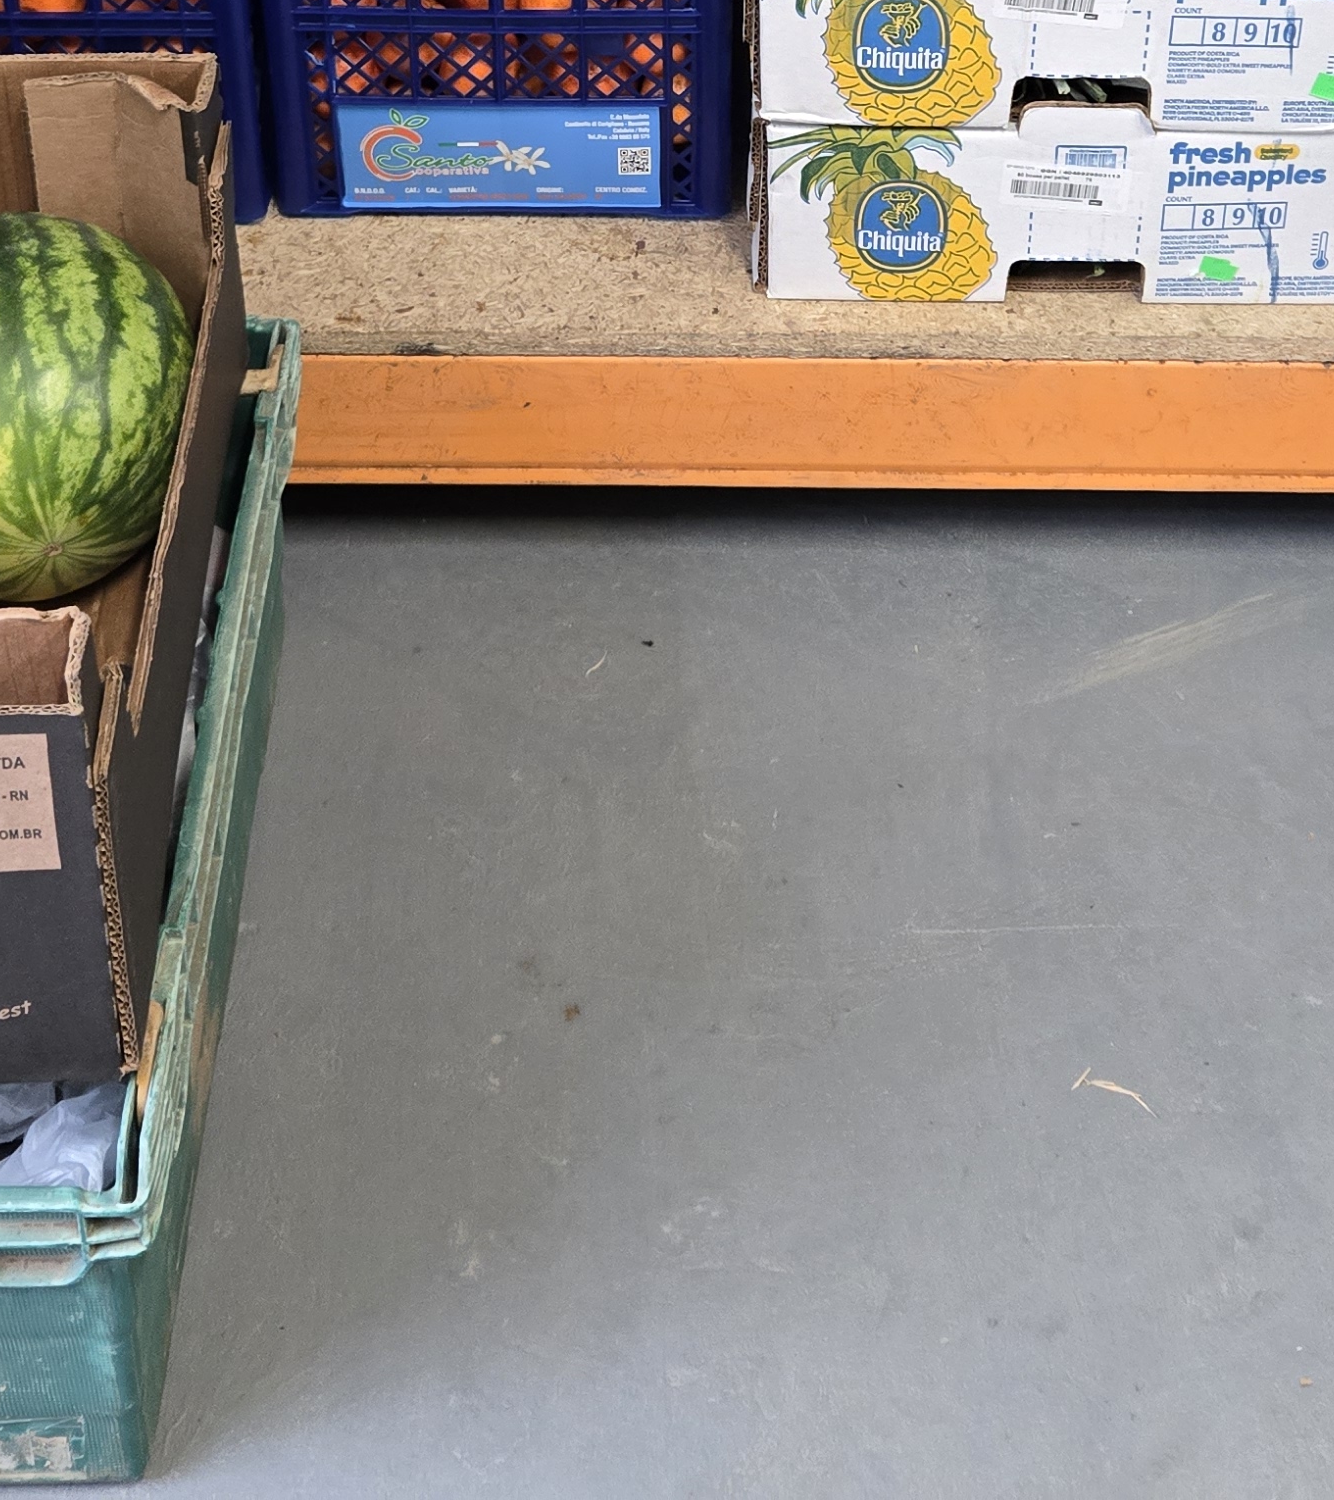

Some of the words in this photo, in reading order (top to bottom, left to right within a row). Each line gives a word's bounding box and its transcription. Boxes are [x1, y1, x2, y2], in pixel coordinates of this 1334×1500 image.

[1174, 7, 1203, 15] COUNT
[1212, 22, 1226, 43] 8
[1243, 22, 1258, 44] 9
[1271, 22, 1297, 44] 10
[856, 46, 945, 76] Chiquita
[376, 143, 494, 170] Santo
[1170, 141, 1251, 164] fresh
[1167, 163, 1327, 193] pineapples
[1165, 195, 1193, 203] COUNT
[1201, 208, 1216, 227] 8
[1232, 207, 1246, 226] 9
[1258, 206, 1283, 227] 10
[858, 229, 943, 257] Chiquita
[9, 790, 30, 802] RN
